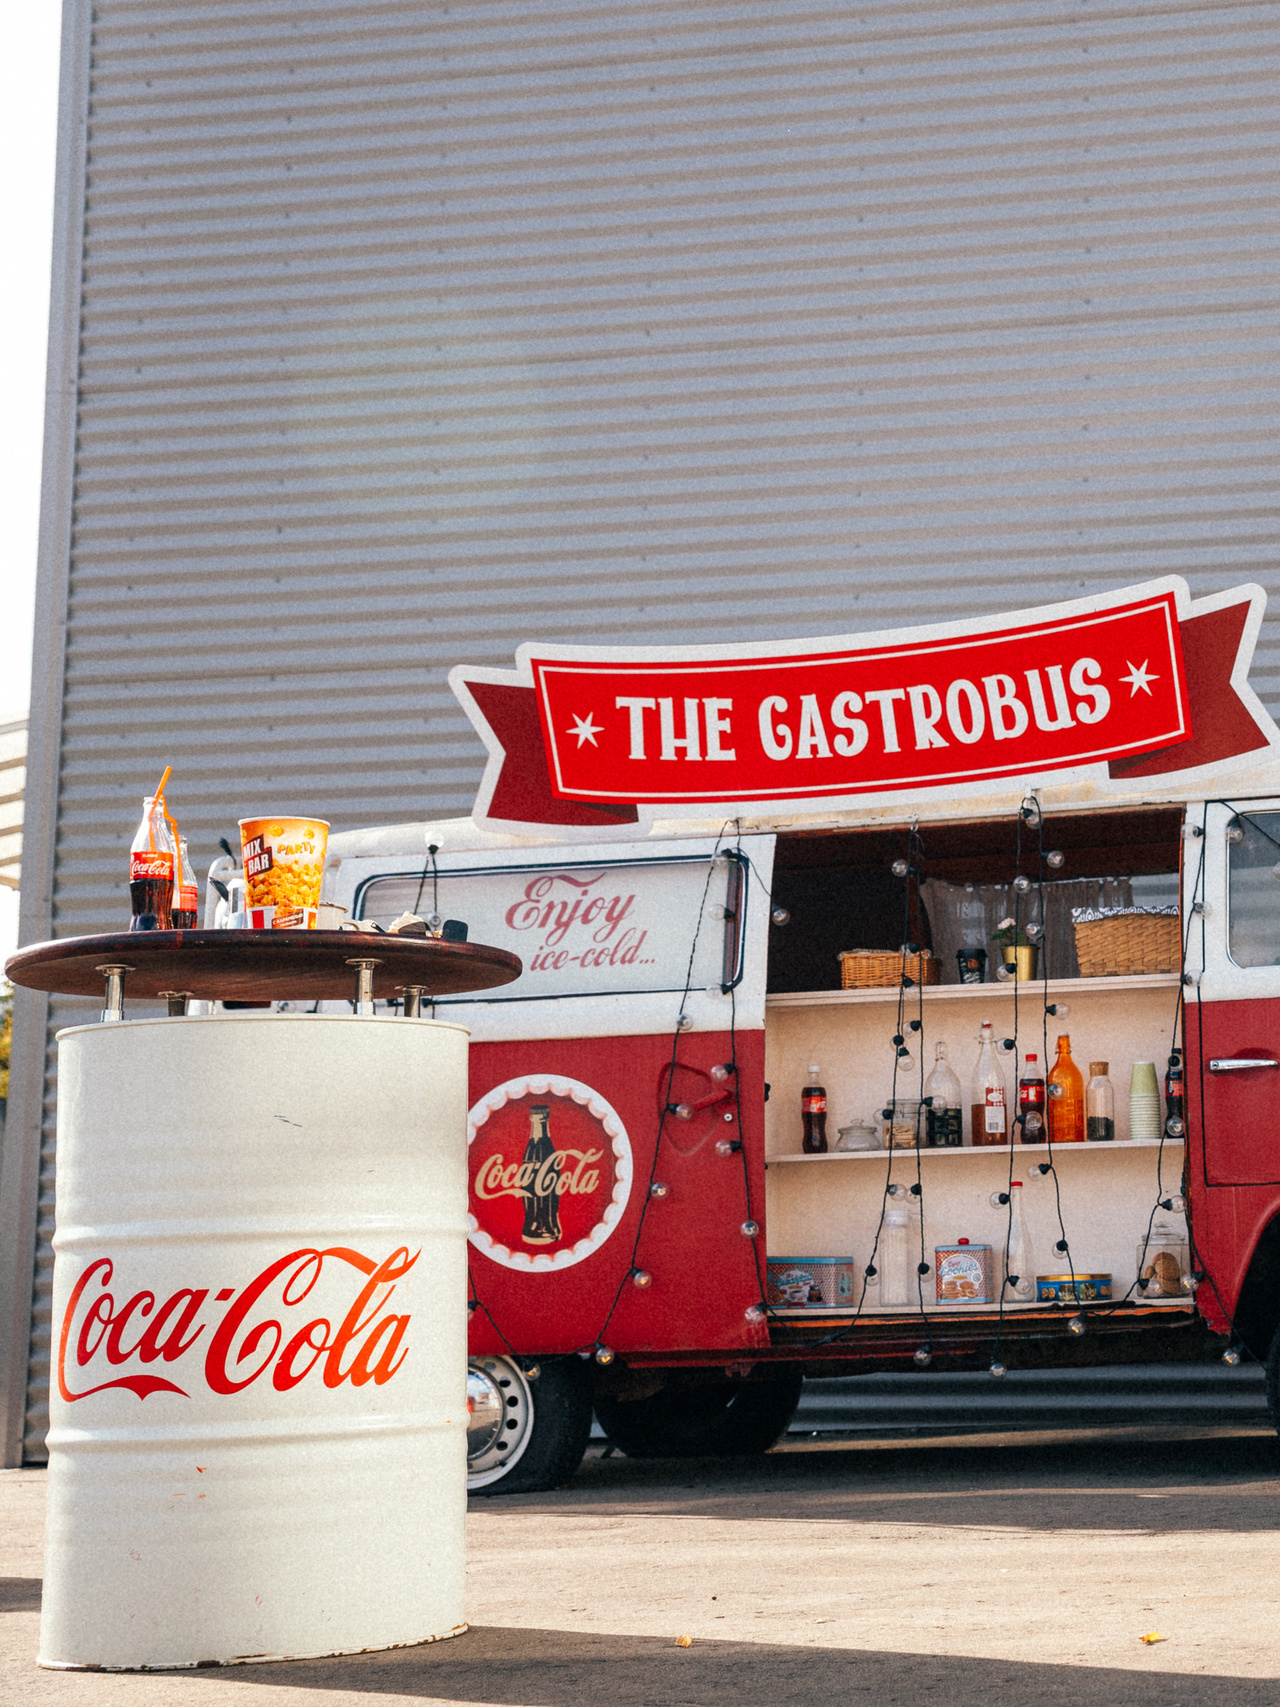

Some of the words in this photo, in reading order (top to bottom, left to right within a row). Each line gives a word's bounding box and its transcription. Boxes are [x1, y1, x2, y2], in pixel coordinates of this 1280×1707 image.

[615, 695, 737, 762] THE
[757, 656, 1113, 763] GASTROBUS
[131, 860, 172, 877] Coca-Cola
[243, 838, 262, 861] MIX
[248, 853, 270, 877] BAR
[277, 841, 316, 856] PARTY
[505, 872, 637, 947] Enjoy
[529, 927, 656, 972] ice-cold...
[474, 1147, 605, 1200] Coca-Cola
[57, 1245, 423, 1403] Coca-Cola
